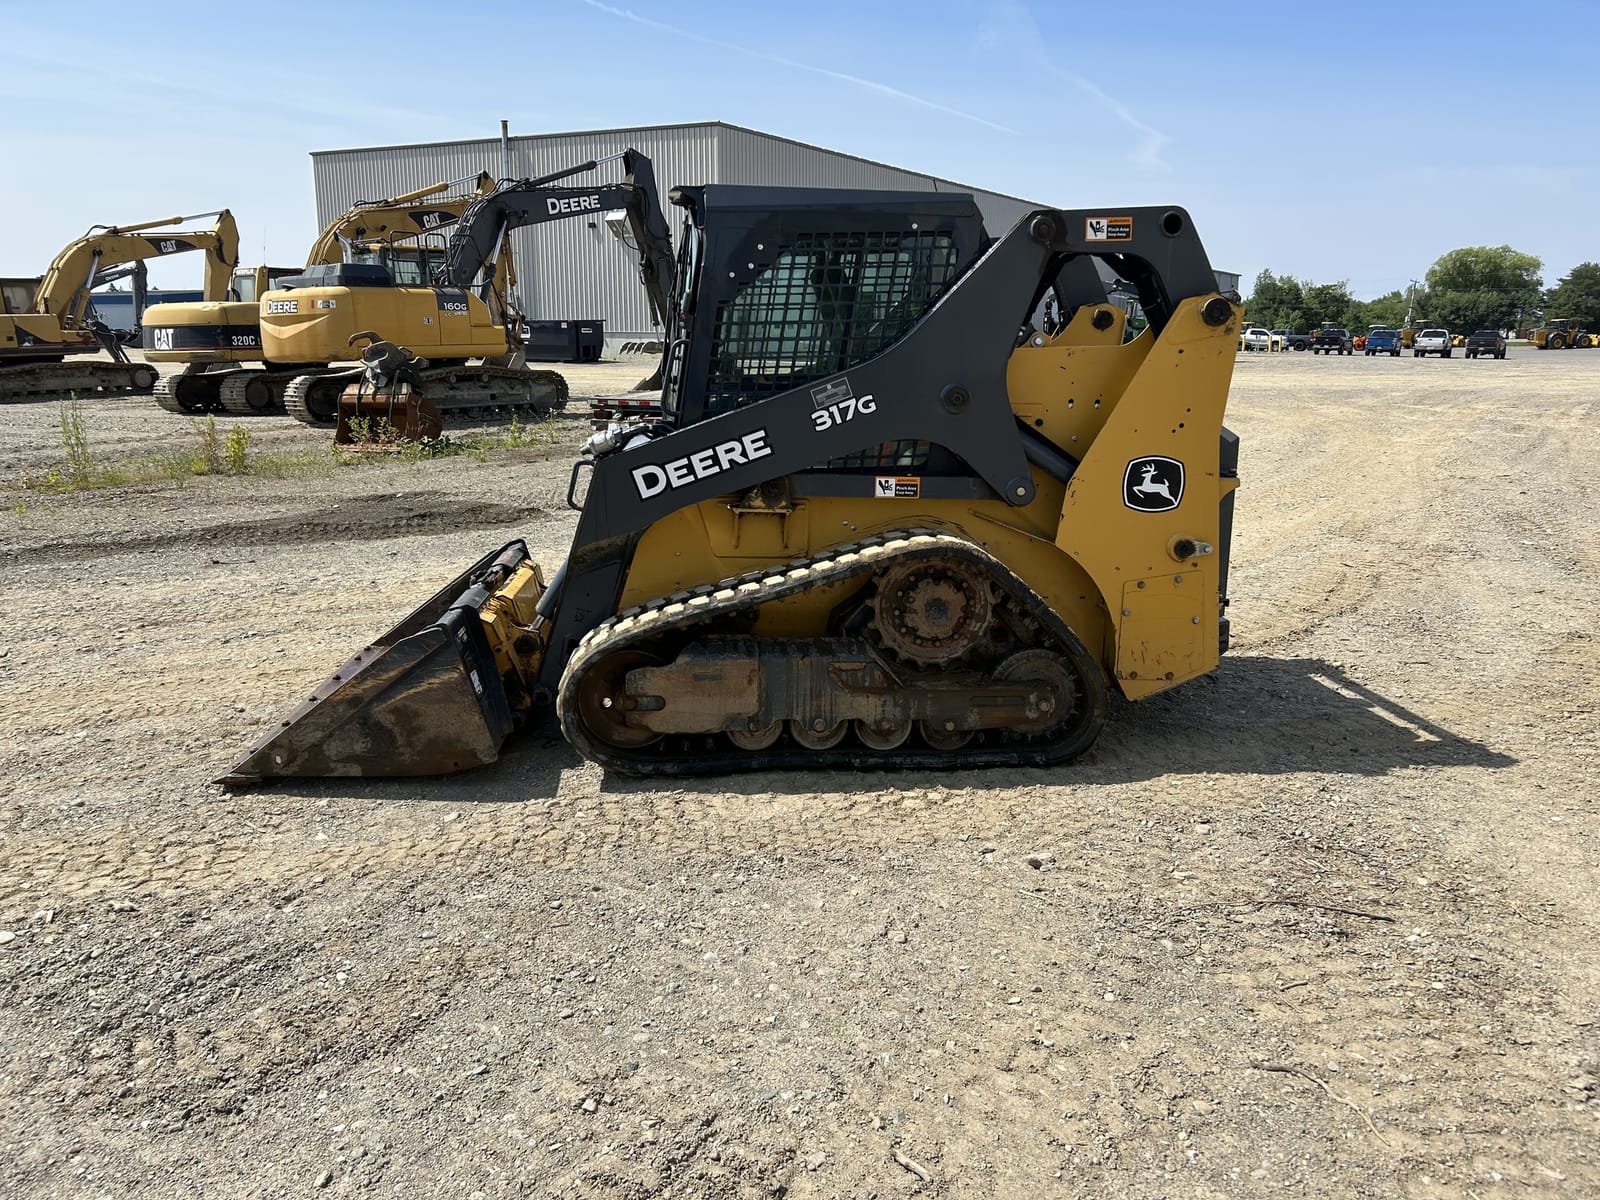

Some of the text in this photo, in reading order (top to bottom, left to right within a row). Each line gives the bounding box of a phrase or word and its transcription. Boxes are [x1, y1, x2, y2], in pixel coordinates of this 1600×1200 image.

[546, 195, 600, 215] DEERE
[423, 212, 440, 229] CAT
[160, 240, 177, 253] CAT
[267, 300, 298, 314] DEERE
[443, 302, 467, 310] 160G
[154, 328, 174, 350] CAT
[231, 335, 256, 346] 320C
[810, 394, 877, 431] 317G
[632, 430, 772, 500] DEERE
